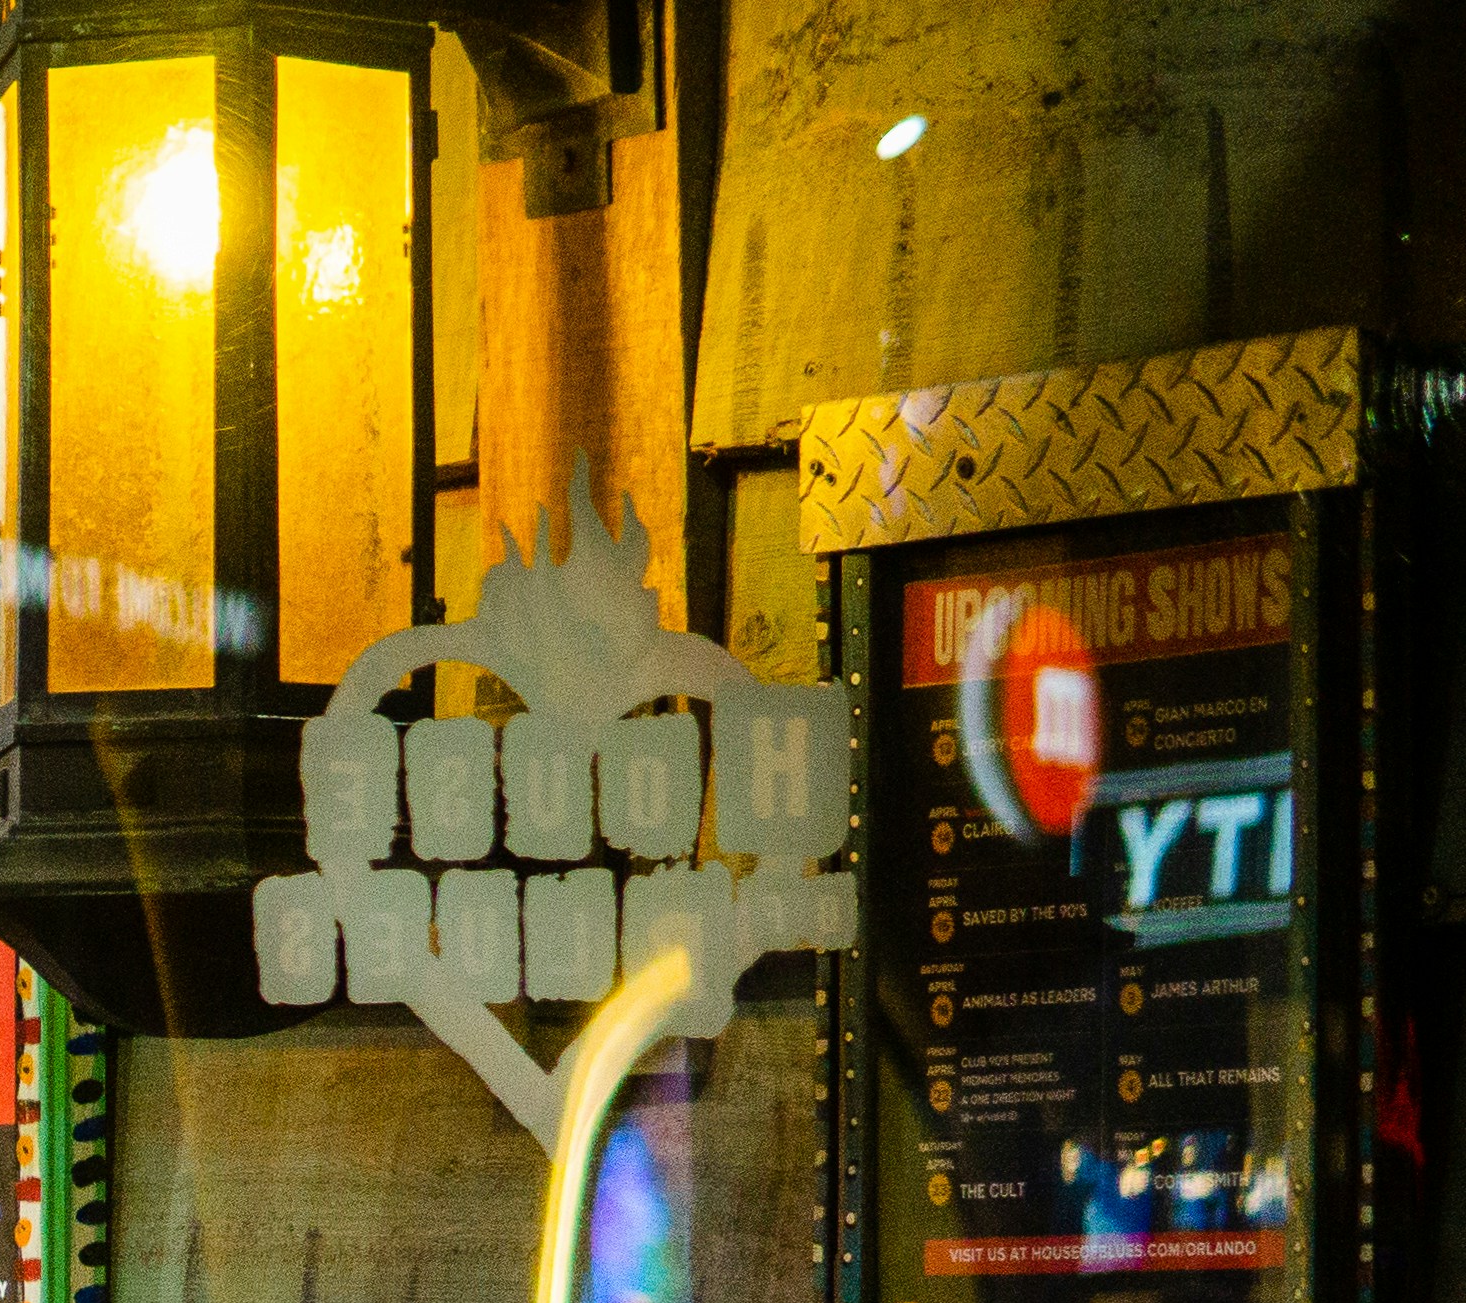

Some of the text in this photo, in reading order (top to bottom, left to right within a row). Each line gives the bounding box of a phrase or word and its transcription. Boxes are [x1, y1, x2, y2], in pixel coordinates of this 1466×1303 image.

[933, 548, 1293, 667] UPCOMING SHOWS
[1193, 698, 1245, 719] MARCO
[1249, 694, 1268, 713] EN
[1153, 727, 1236, 751] CONCIERTO
[963, 903, 1088, 927] SAVED BY THE 90'S
[962, 987, 1097, 1010] ANIMALS AS LEADERS
[1150, 976, 1259, 998] JAMES ARTHUR
[961, 1056, 987, 1068] CLUB
[1149, 1065, 1281, 1089] ALL THAT REMAINS
[970, 1093, 990, 1105] ONE
[992, 1091, 1043, 1104] DIRECTION
[960, 1182, 1026, 1199] THE CULT
[949, 1247, 984, 1263] VISIT
[987, 1247, 1006, 1261] US
[1009, 1247, 1028, 1261] AT
